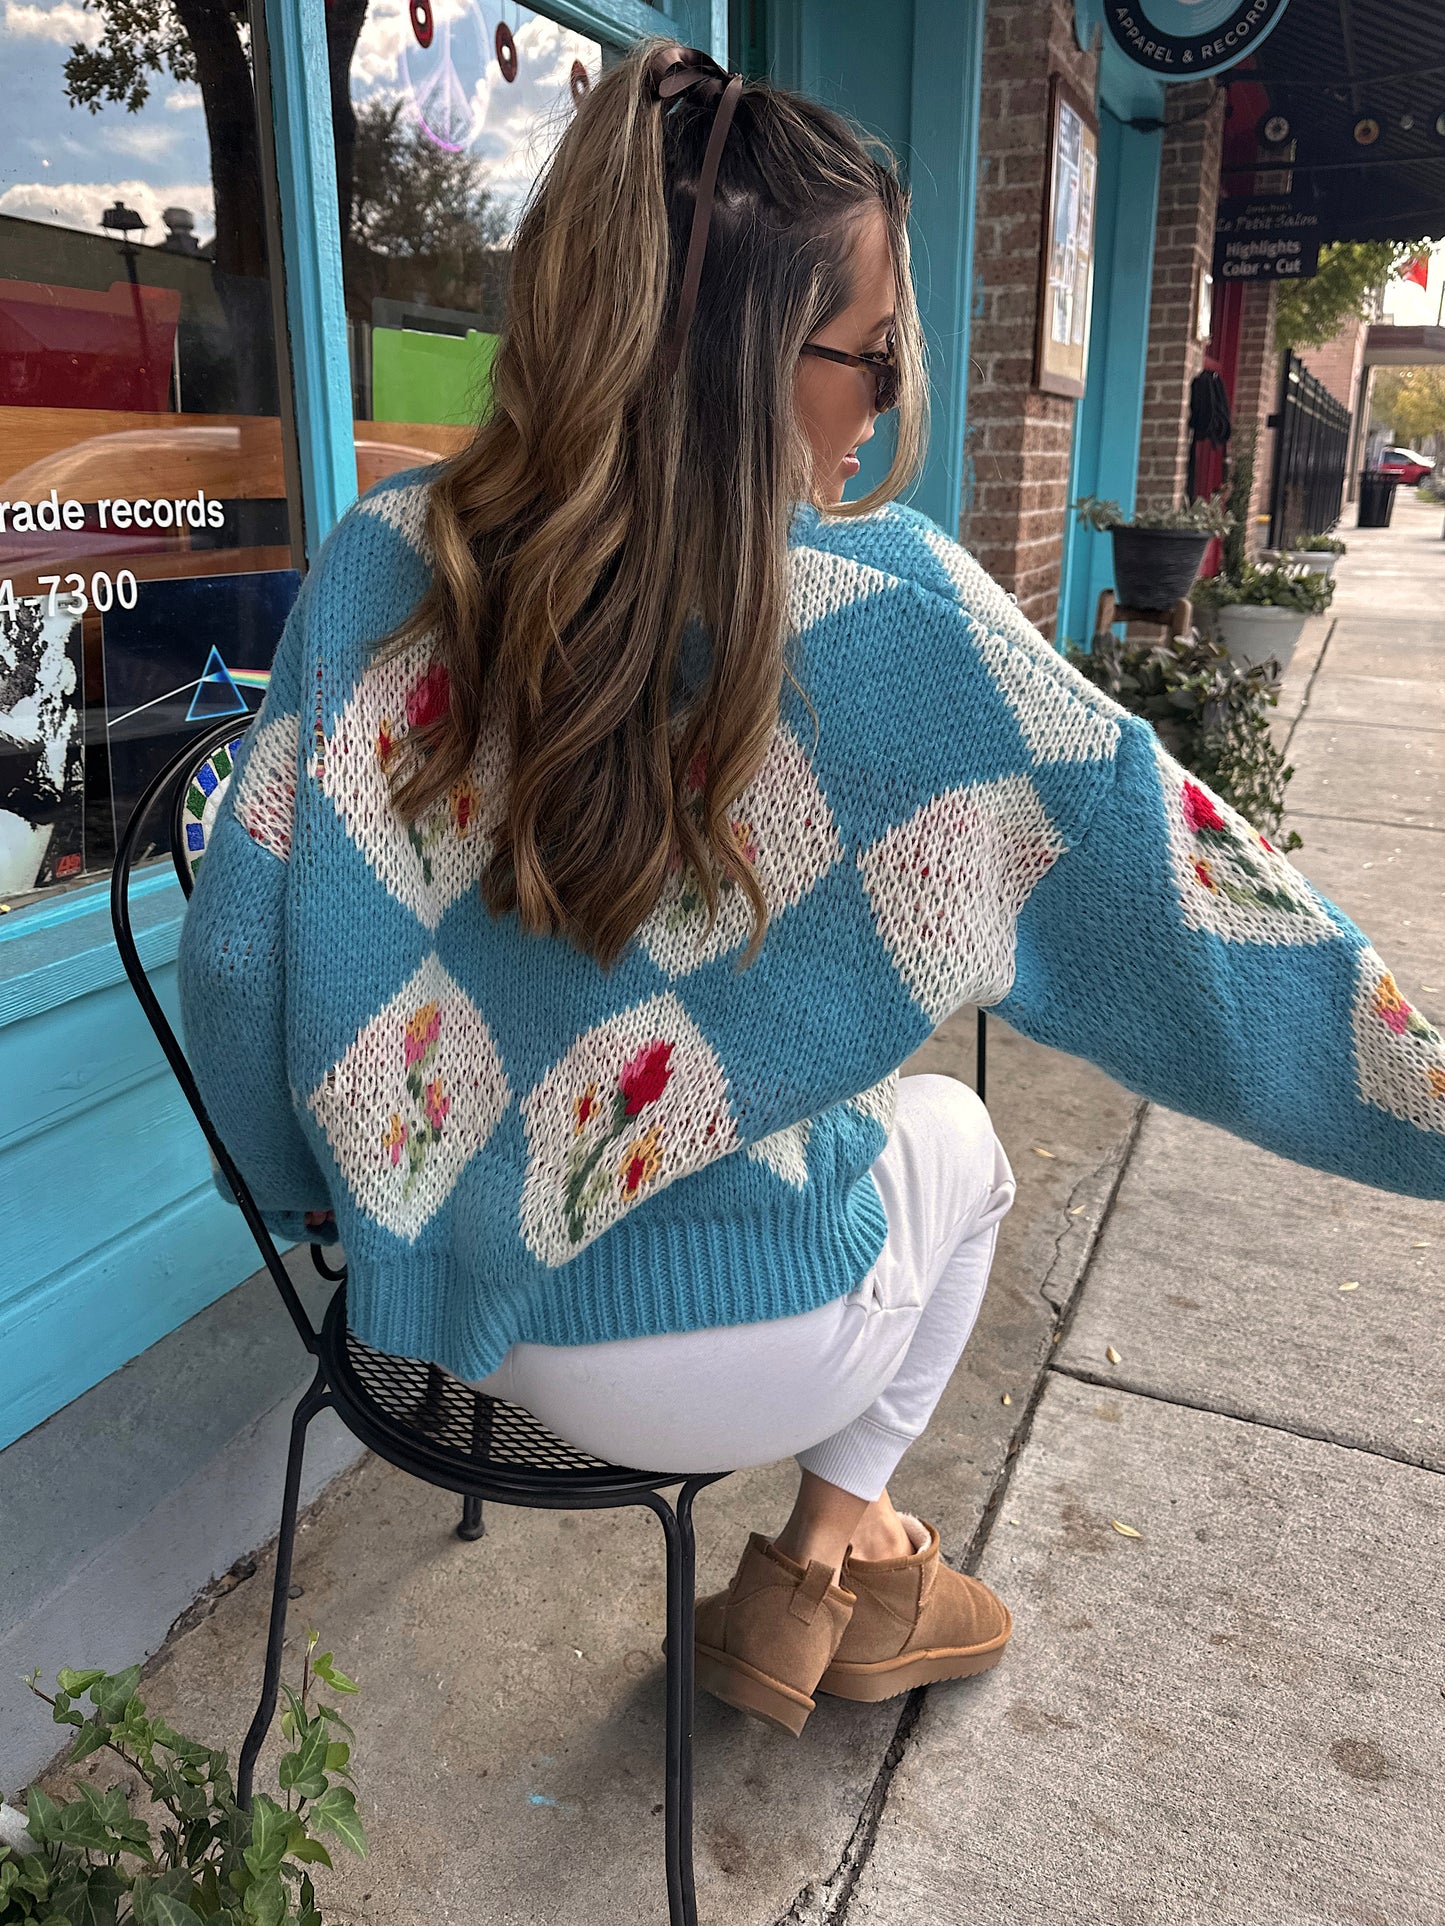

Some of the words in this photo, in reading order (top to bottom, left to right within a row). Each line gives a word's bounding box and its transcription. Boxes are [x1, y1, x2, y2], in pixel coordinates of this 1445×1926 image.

[1116, 7, 1174, 63] APPAREL
[1182, 50, 1194, 64] &
[1275, 212, 1318, 228] Salon
[1226, 240, 1301, 260] Highlights
[1222, 261, 1260, 277] Color
[1276, 258, 1302, 274] Cut
[0, 489, 85, 532] rade
[98, 490, 225, 529] records
[0, 569, 138, 622] 4-7300
